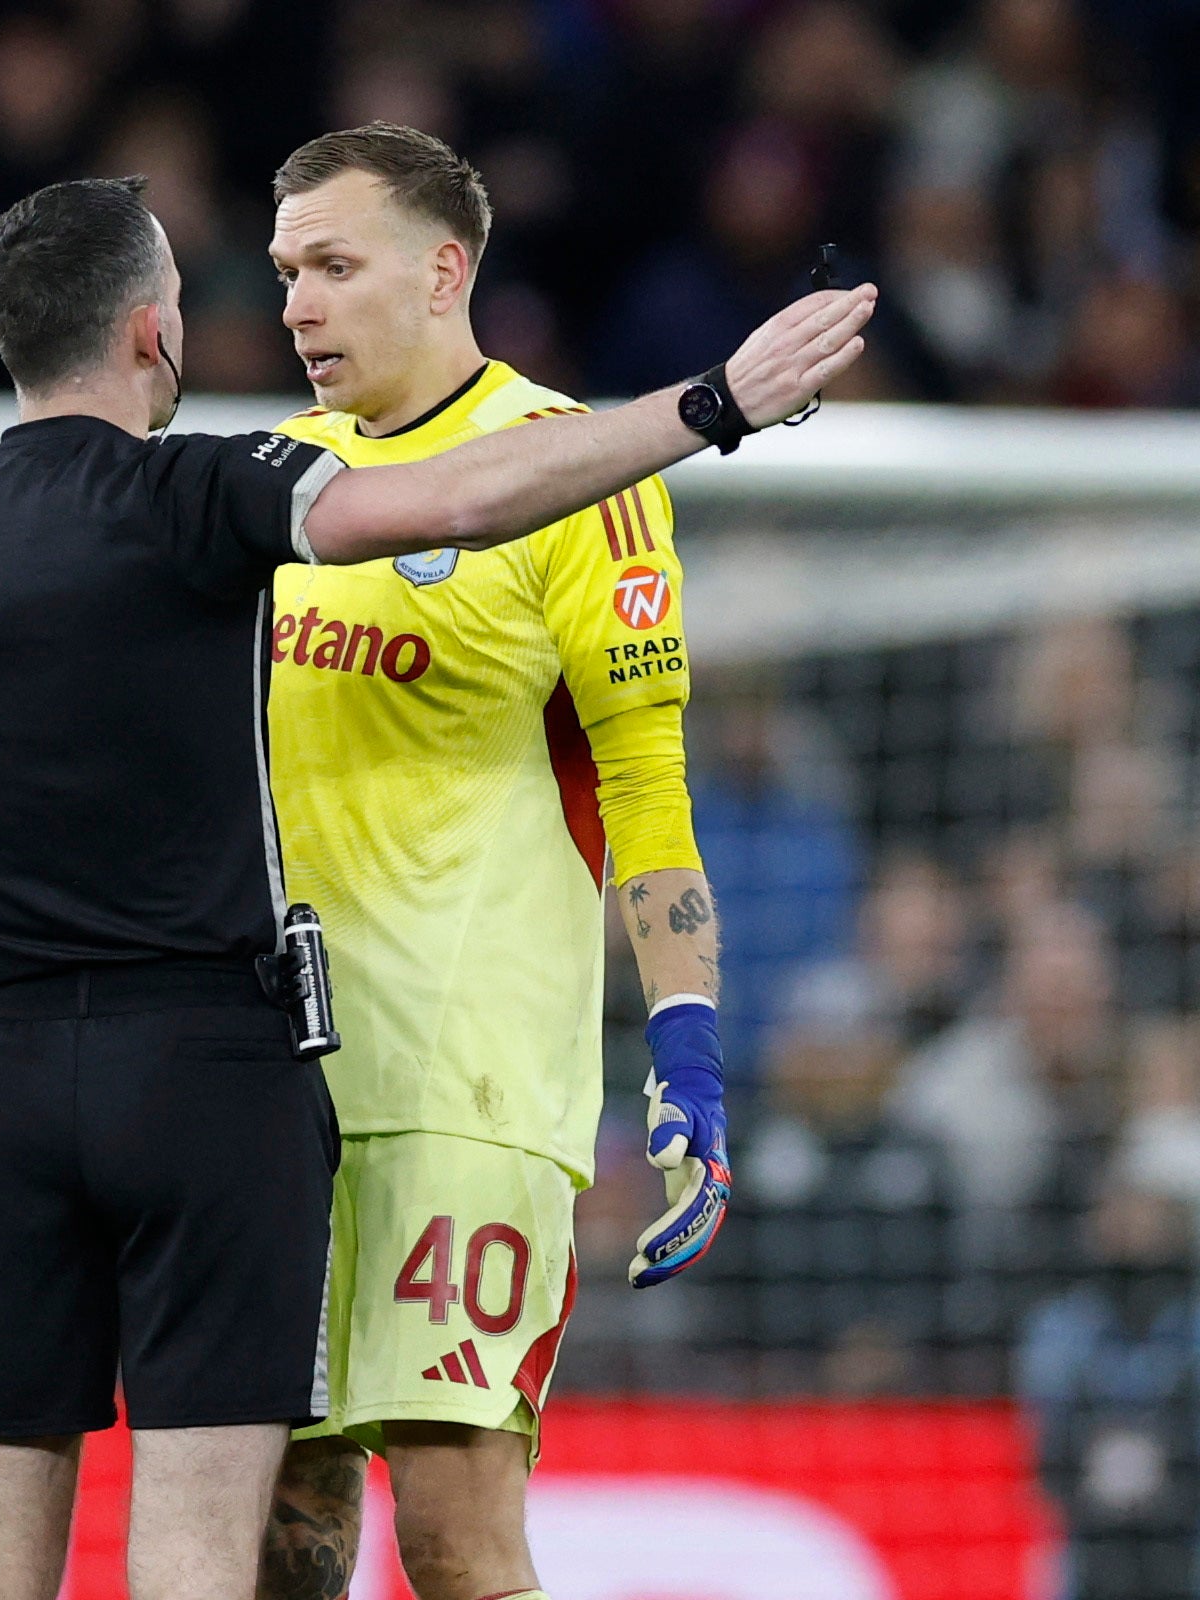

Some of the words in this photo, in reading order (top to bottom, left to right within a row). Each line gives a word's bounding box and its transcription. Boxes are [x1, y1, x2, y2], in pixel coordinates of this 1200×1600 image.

[400, 562, 421, 578] ASTON
[423, 568, 445, 579] VILLA
[272, 602, 431, 683] etano
[605, 636, 683, 664] TRAD
[609, 657, 687, 684] NATIO
[654, 1186, 720, 1262] reusch
[394, 1215, 532, 1337] 40
